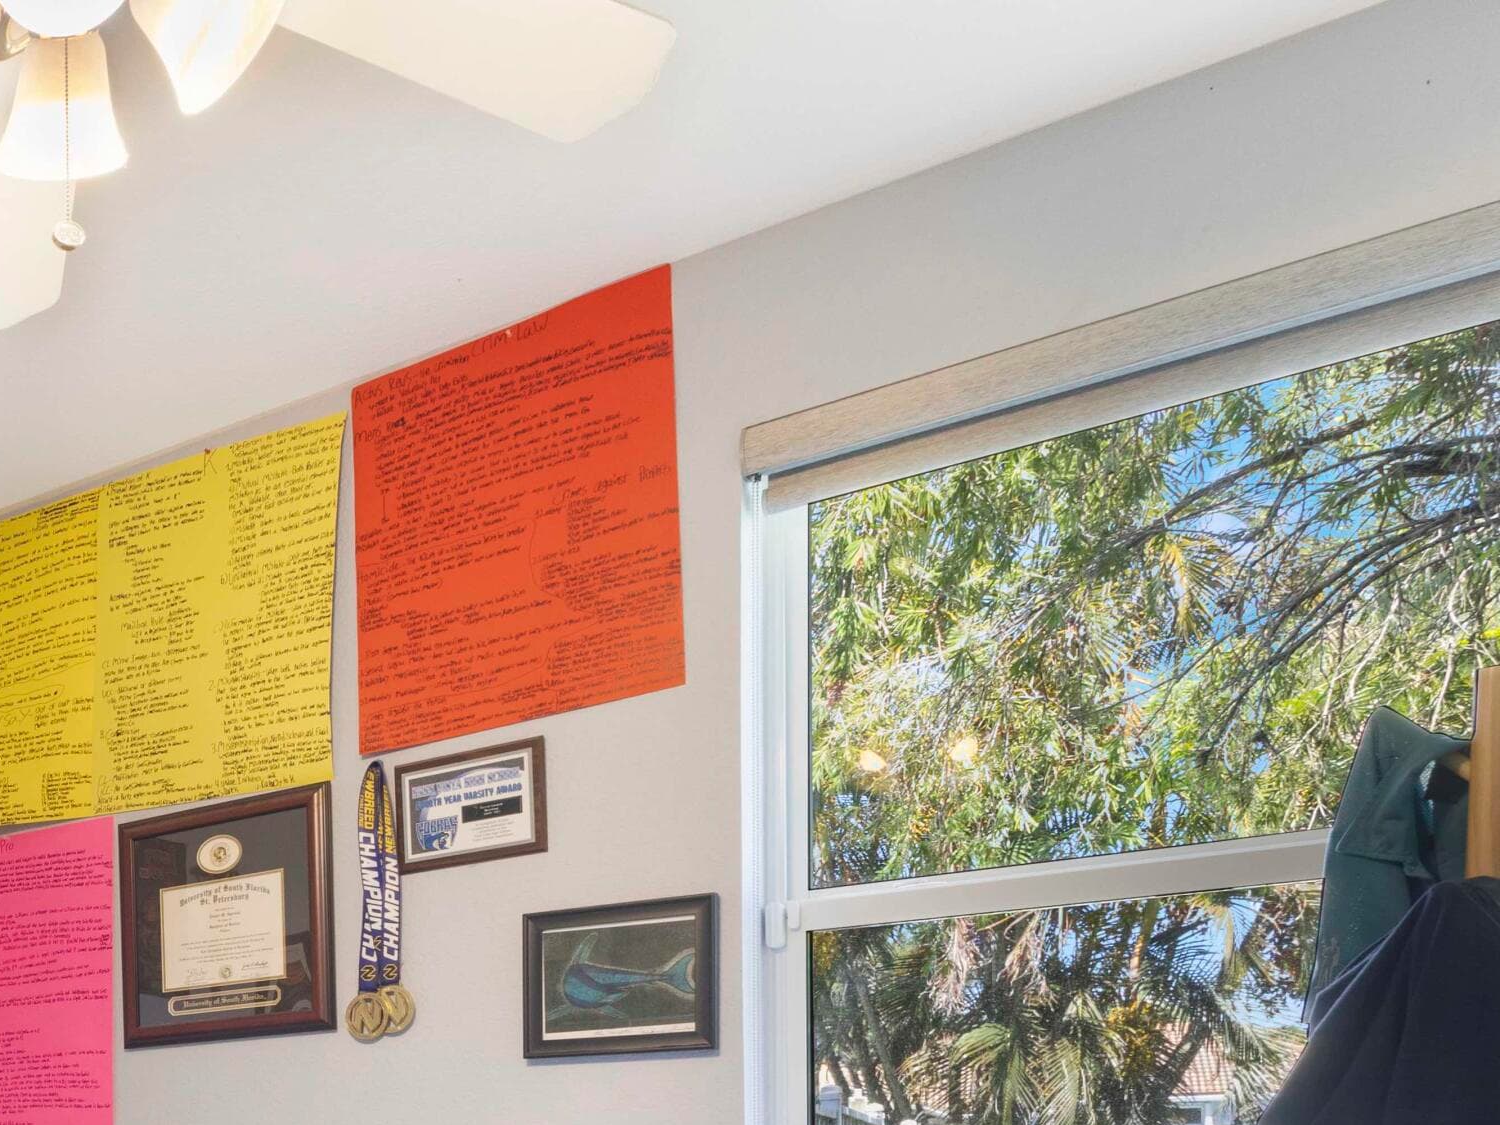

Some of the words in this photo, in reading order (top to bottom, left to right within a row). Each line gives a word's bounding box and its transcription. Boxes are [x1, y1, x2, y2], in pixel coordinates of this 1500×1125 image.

[516, 315, 550, 343] Law
[443, 795, 462, 805] YEAR
[463, 788, 495, 801] VARSITY
[496, 781, 523, 796] AWARD
[179, 888, 213, 908] University
[214, 885, 222, 894] of
[223, 883, 244, 893] South
[245, 882, 271, 895] Florida
[200, 897, 211, 906] St.
[213, 892, 250, 904] Petersburg
[382, 856, 400, 961] CHAMPION
